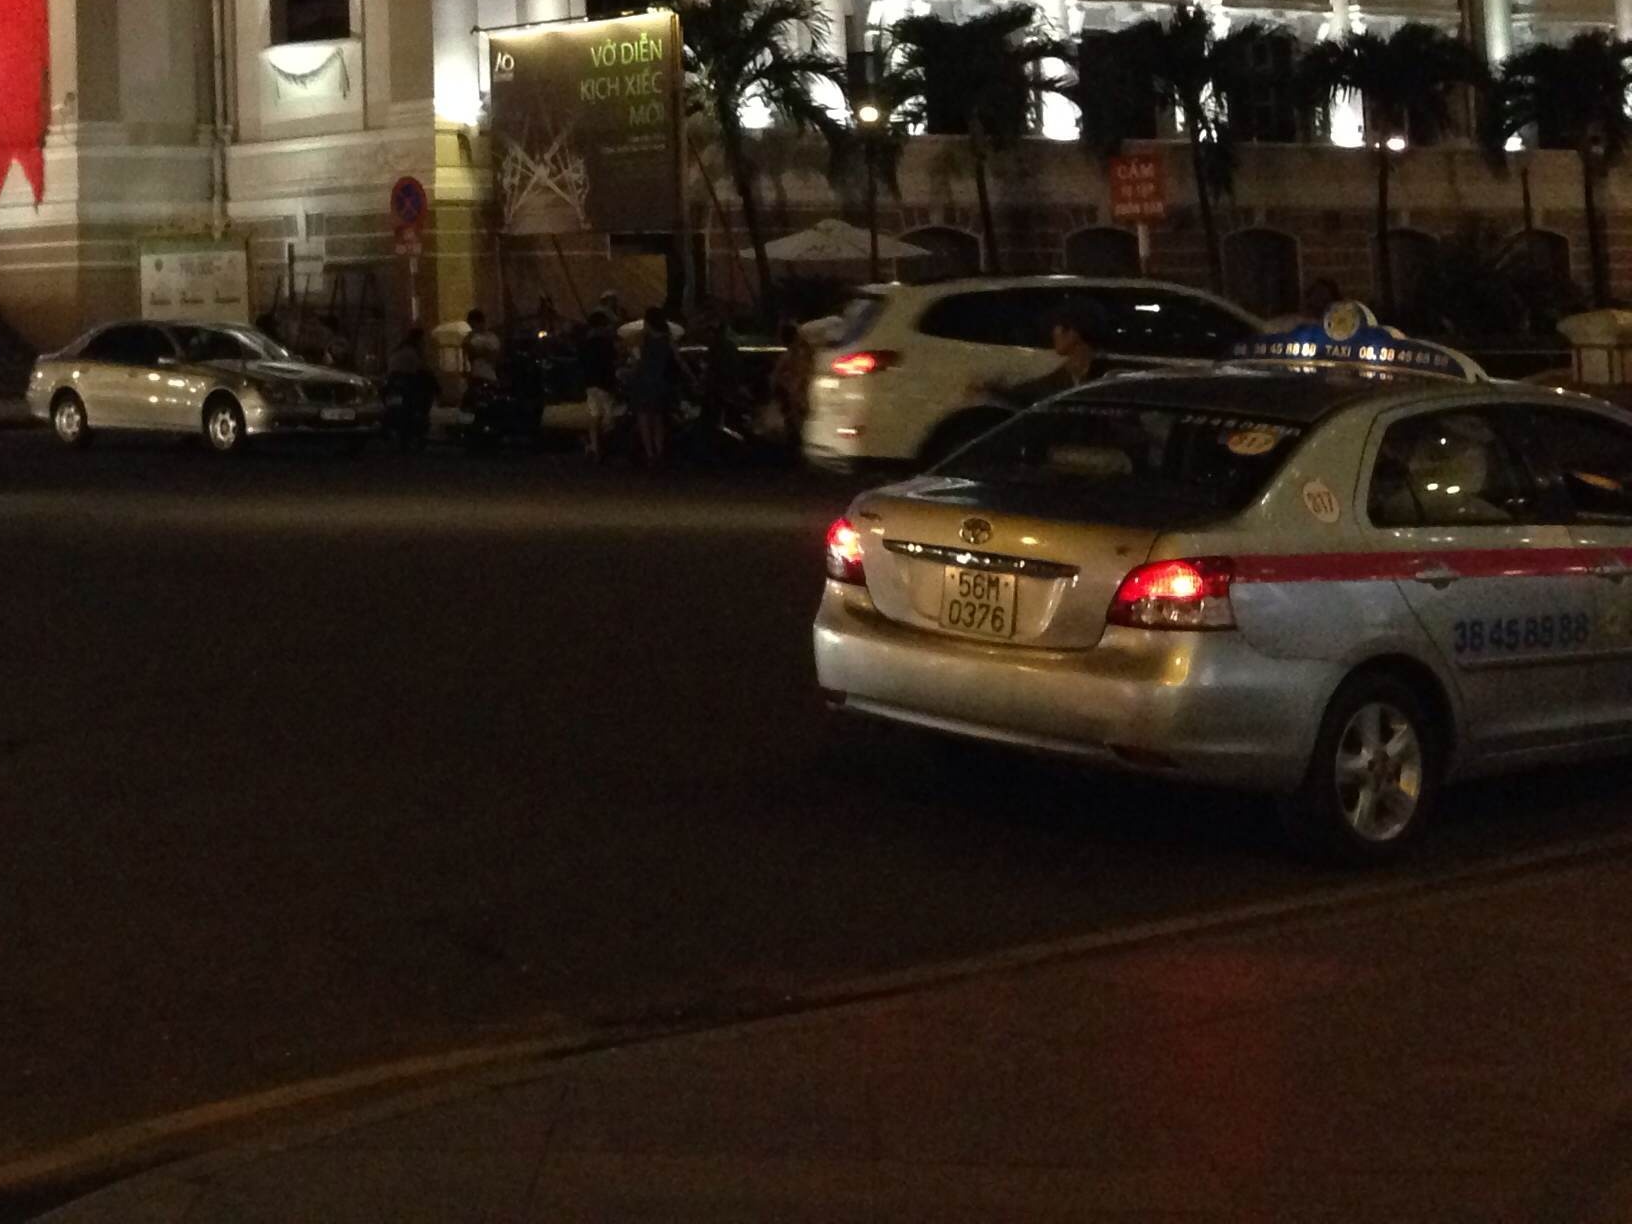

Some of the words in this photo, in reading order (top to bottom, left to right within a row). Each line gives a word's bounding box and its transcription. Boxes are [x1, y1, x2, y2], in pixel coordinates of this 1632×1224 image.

[1325, 344, 1352, 358] TAXI
[958, 573, 1001, 602] 56M
[948, 600, 1006, 633] 0376
